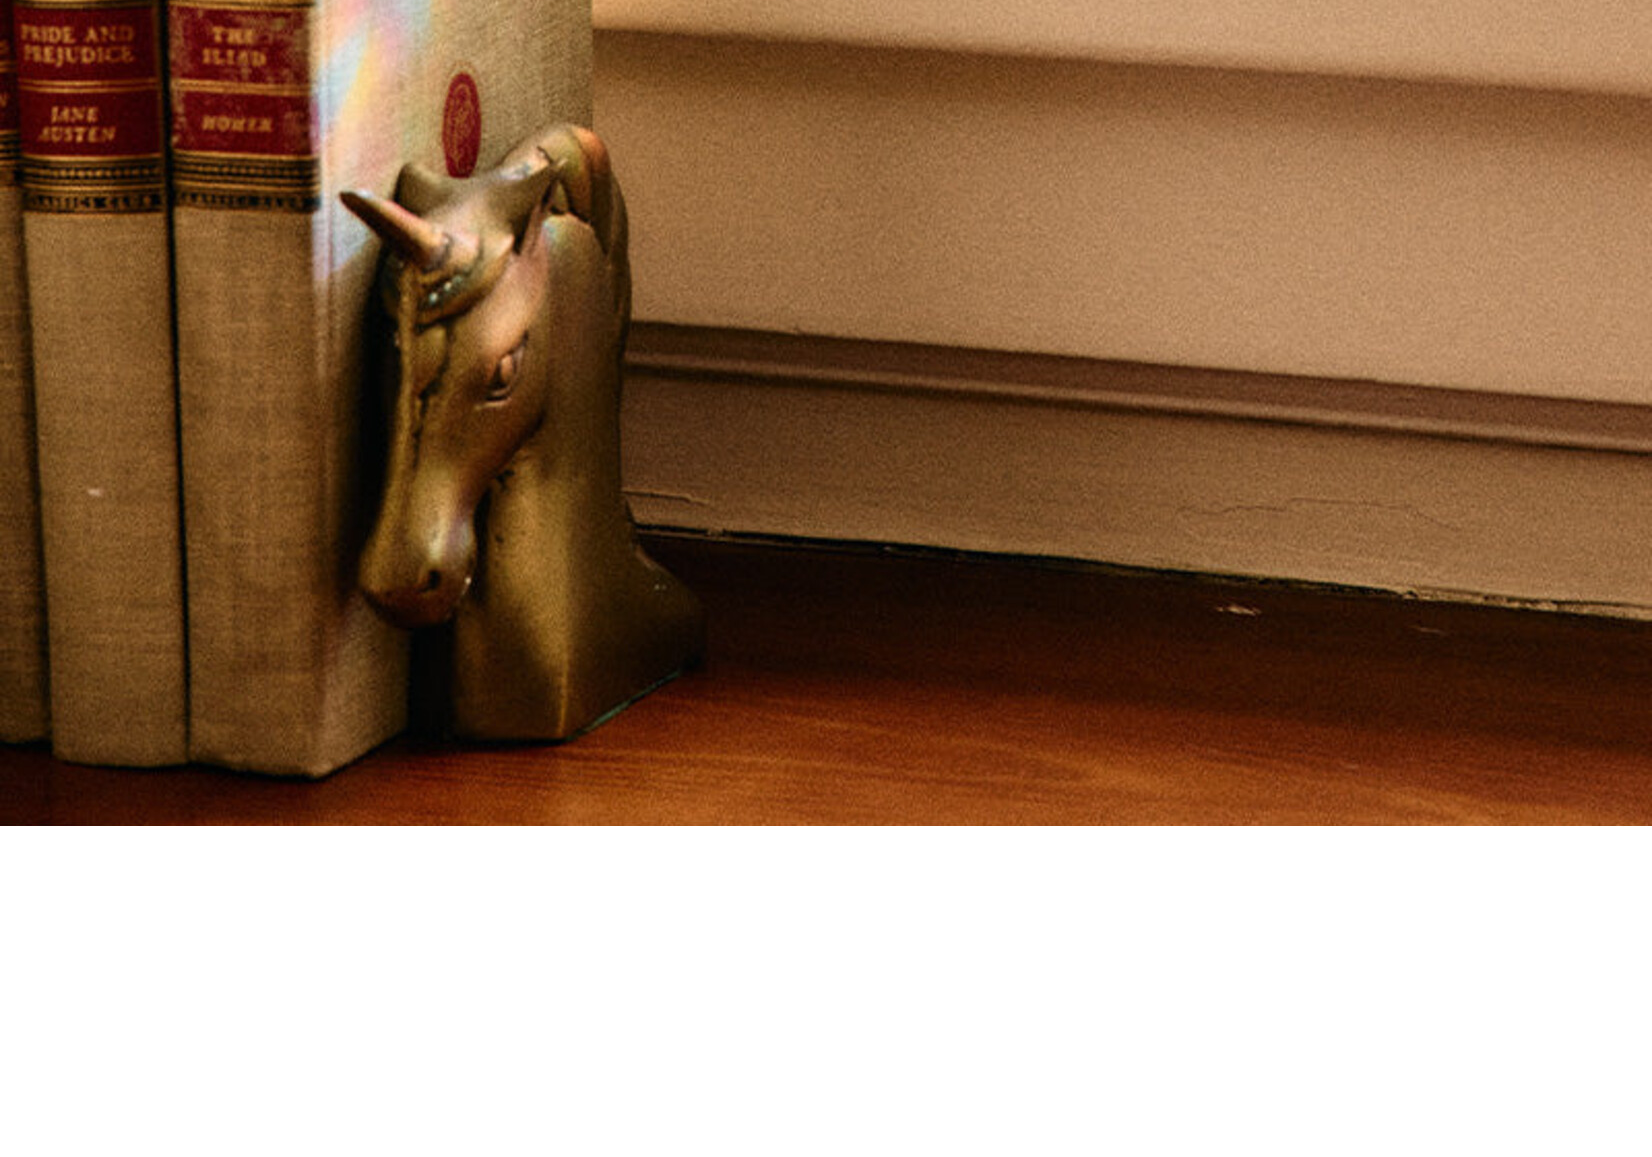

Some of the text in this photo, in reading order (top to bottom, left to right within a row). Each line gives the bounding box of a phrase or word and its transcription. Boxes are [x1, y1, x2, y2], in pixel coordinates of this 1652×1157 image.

[21, 24, 135, 44] PRIDE AND
[212, 26, 253, 44] THE
[24, 44, 135, 68] PREJUDICE
[202, 48, 267, 67] ILIAD
[51, 106, 99, 123] JANE
[202, 115, 273, 133] HOMER
[38, 126, 117, 143] AUSTEN
